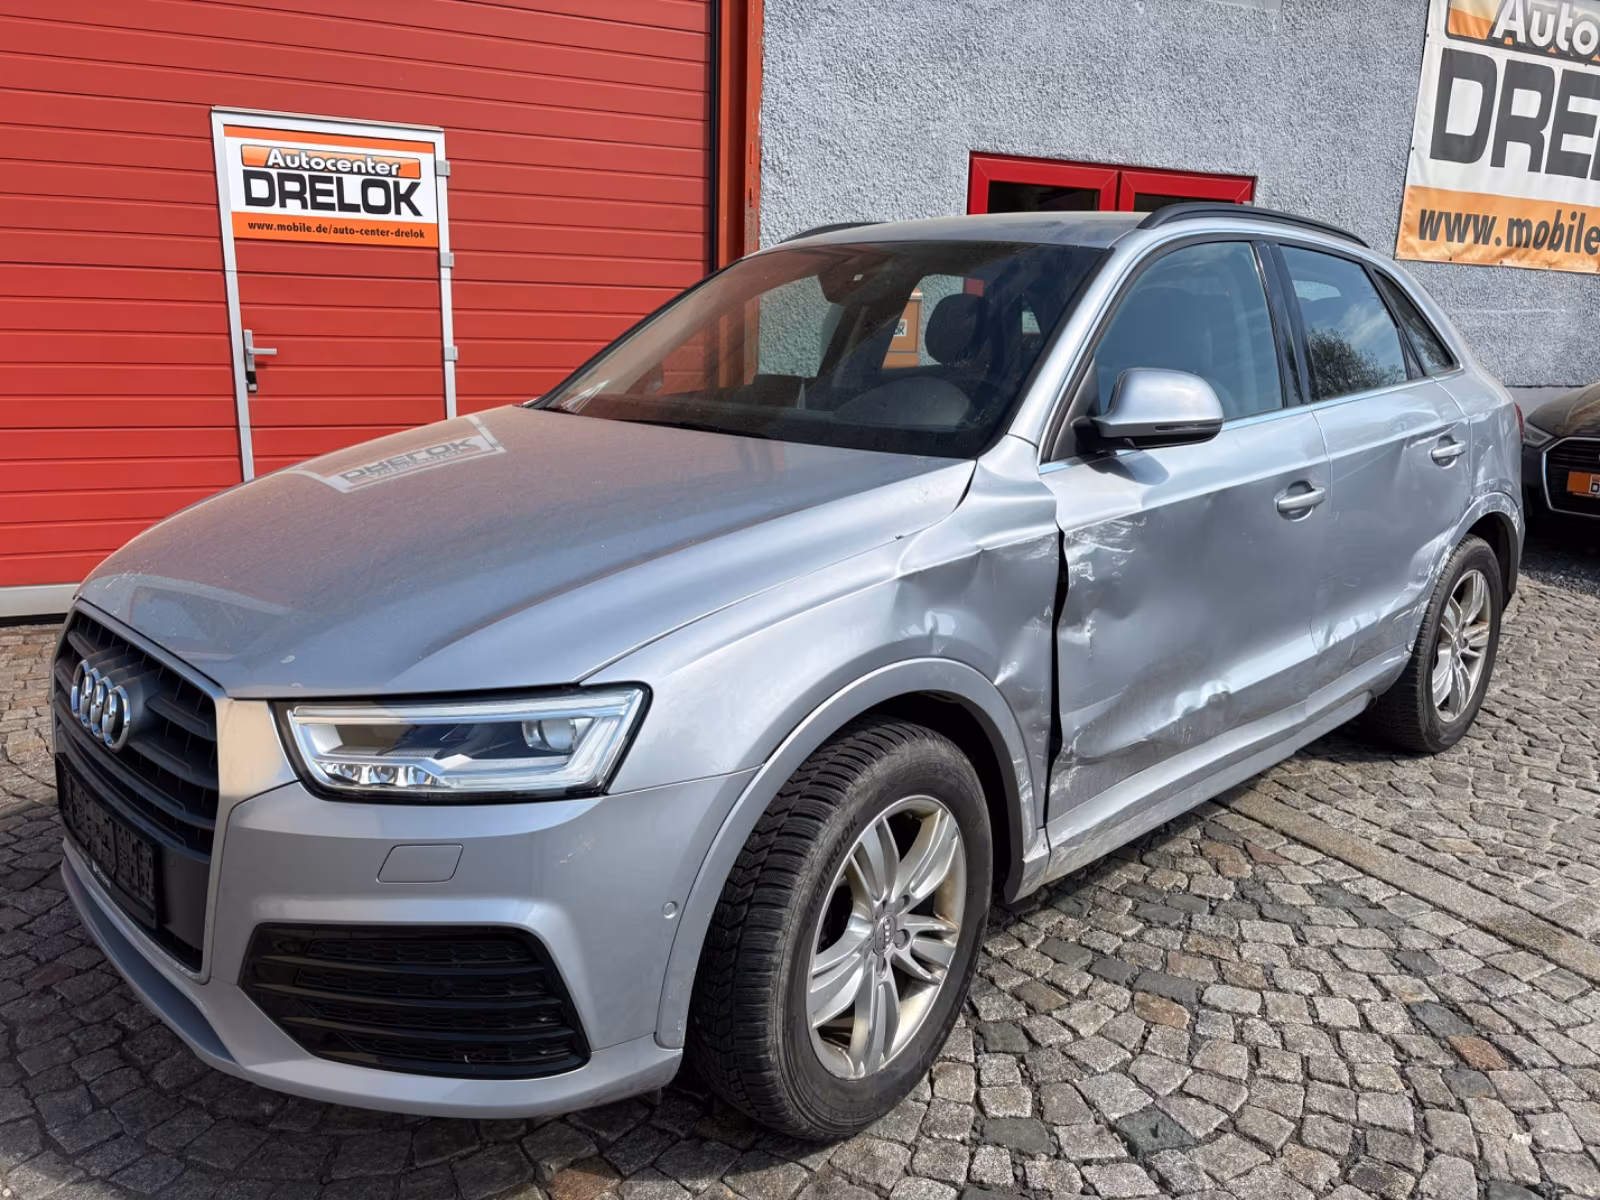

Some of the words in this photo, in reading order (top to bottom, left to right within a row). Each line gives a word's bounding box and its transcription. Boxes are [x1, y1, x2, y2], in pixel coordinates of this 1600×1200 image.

[1429, 47, 1600, 180] DRE
[266, 148, 400, 177] Autocenter
[242, 169, 423, 217] DRELOK
[247, 220, 425, 239] www.mobile.de/auto-center-drelok
[1418, 209, 1600, 255] www.mobile
